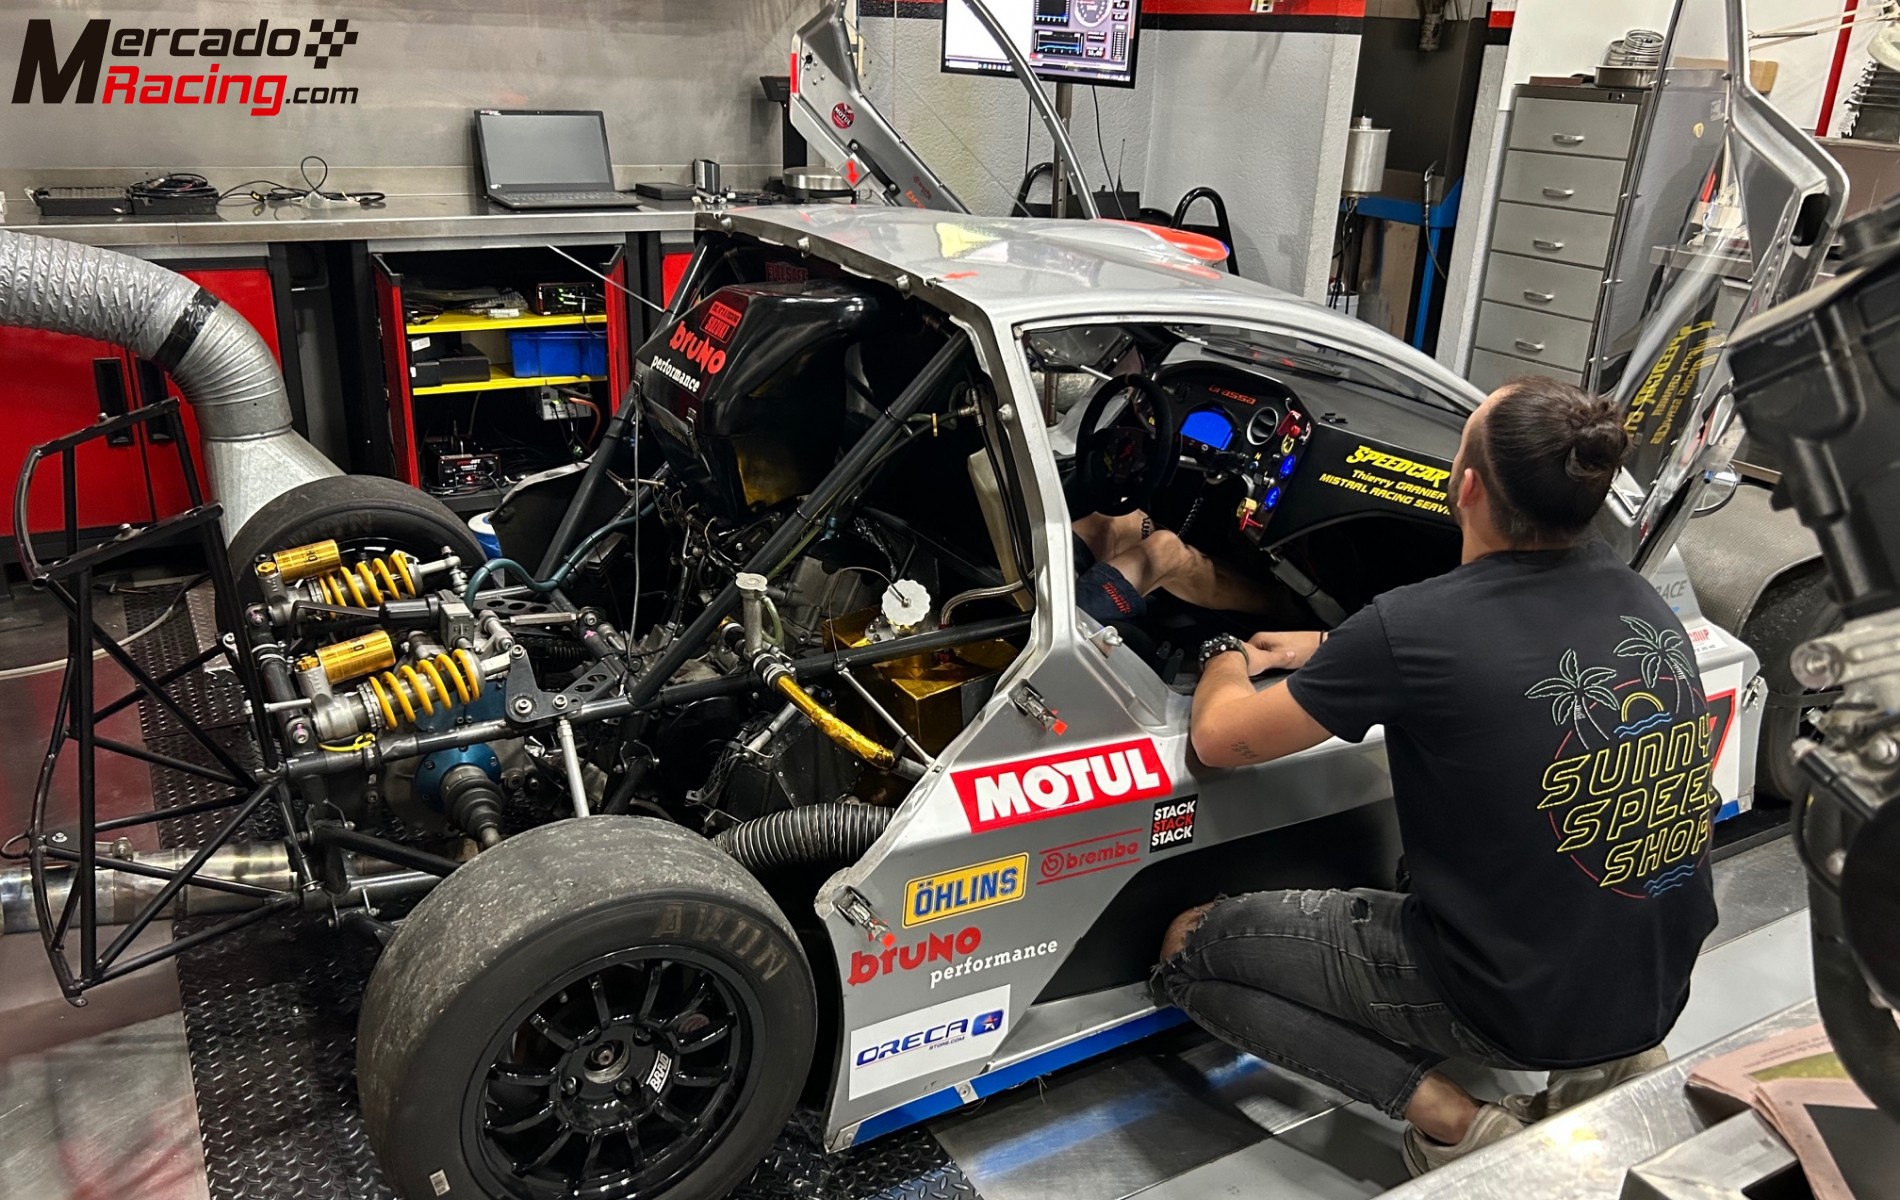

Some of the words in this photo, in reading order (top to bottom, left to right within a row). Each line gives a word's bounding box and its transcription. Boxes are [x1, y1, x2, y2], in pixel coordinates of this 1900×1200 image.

[834, 106, 852, 127] MOTUL
[650, 355, 701, 393] performance
[1345, 444, 1451, 489] SPEEDCAR
[1351, 469, 1395, 488] Thierry
[1395, 481, 1448, 501] GRANIER
[1318, 473, 1369, 494] MISTRAL
[1369, 487, 1414, 505] RACING
[1413, 499, 1451, 516] SERVI
[975, 748, 1161, 822] MOTUL
[1153, 814, 1194, 833] STACK
[1154, 800, 1197, 821] STACK
[1066, 841, 1139, 869] brembo
[1151, 825, 1193, 847] STACK
[914, 866, 1018, 918] ÖHLINS
[929, 938, 1059, 989] performance
[856, 1018, 969, 1067] ORECA
[650, 1052, 670, 1092] BRAID
